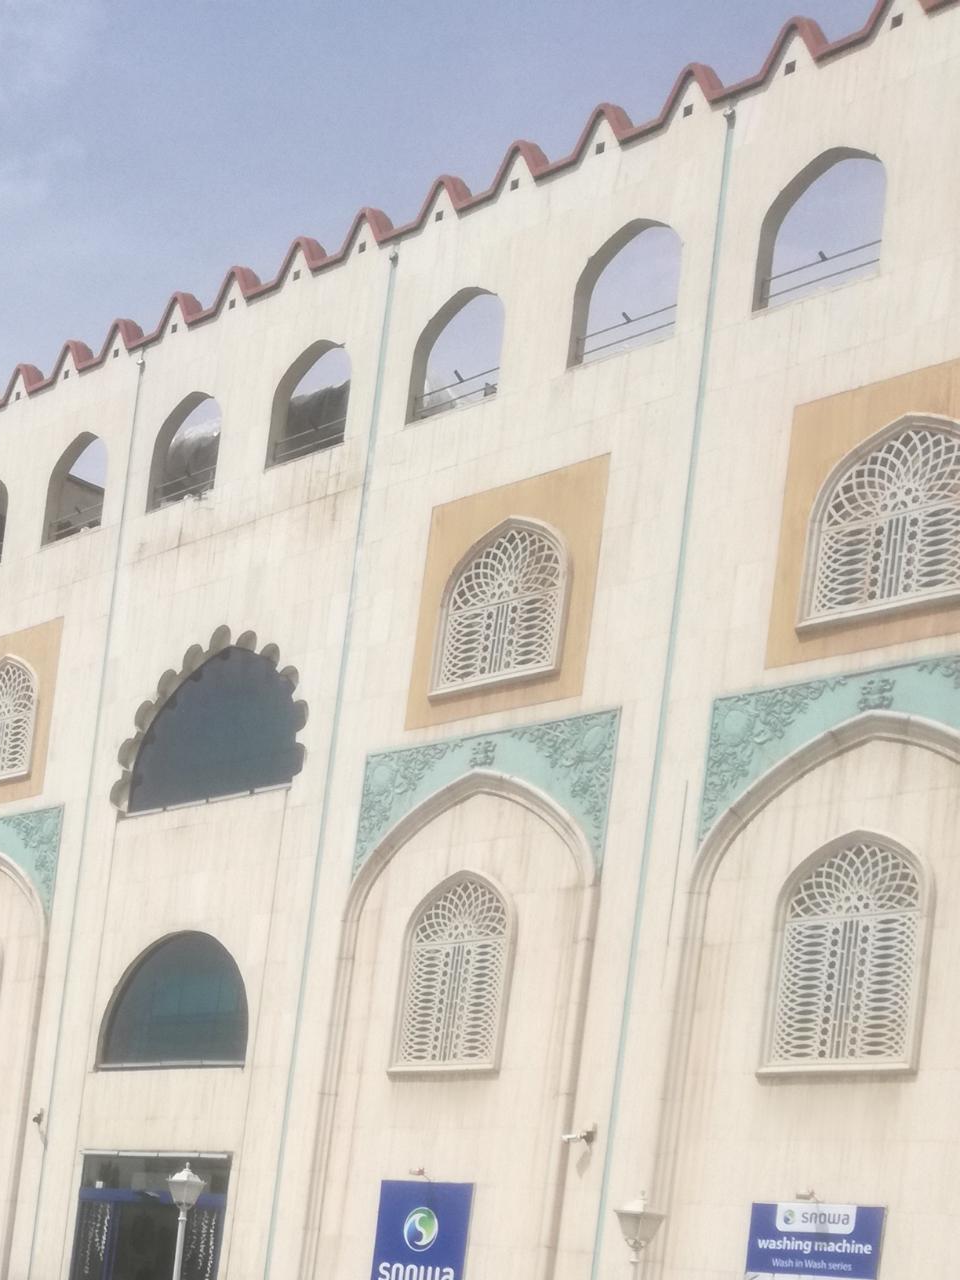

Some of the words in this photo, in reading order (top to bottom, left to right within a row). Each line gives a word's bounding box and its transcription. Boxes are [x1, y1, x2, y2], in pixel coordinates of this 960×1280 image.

[801, 1211, 850, 1226] snowa
[757, 1237, 812, 1254] washing
[814, 1239, 873, 1255] machine
[772, 1258, 794, 1268] Wash
[795, 1260, 803, 1268] in
[804, 1260, 827, 1270] Wash
[828, 1263, 852, 1272] series
